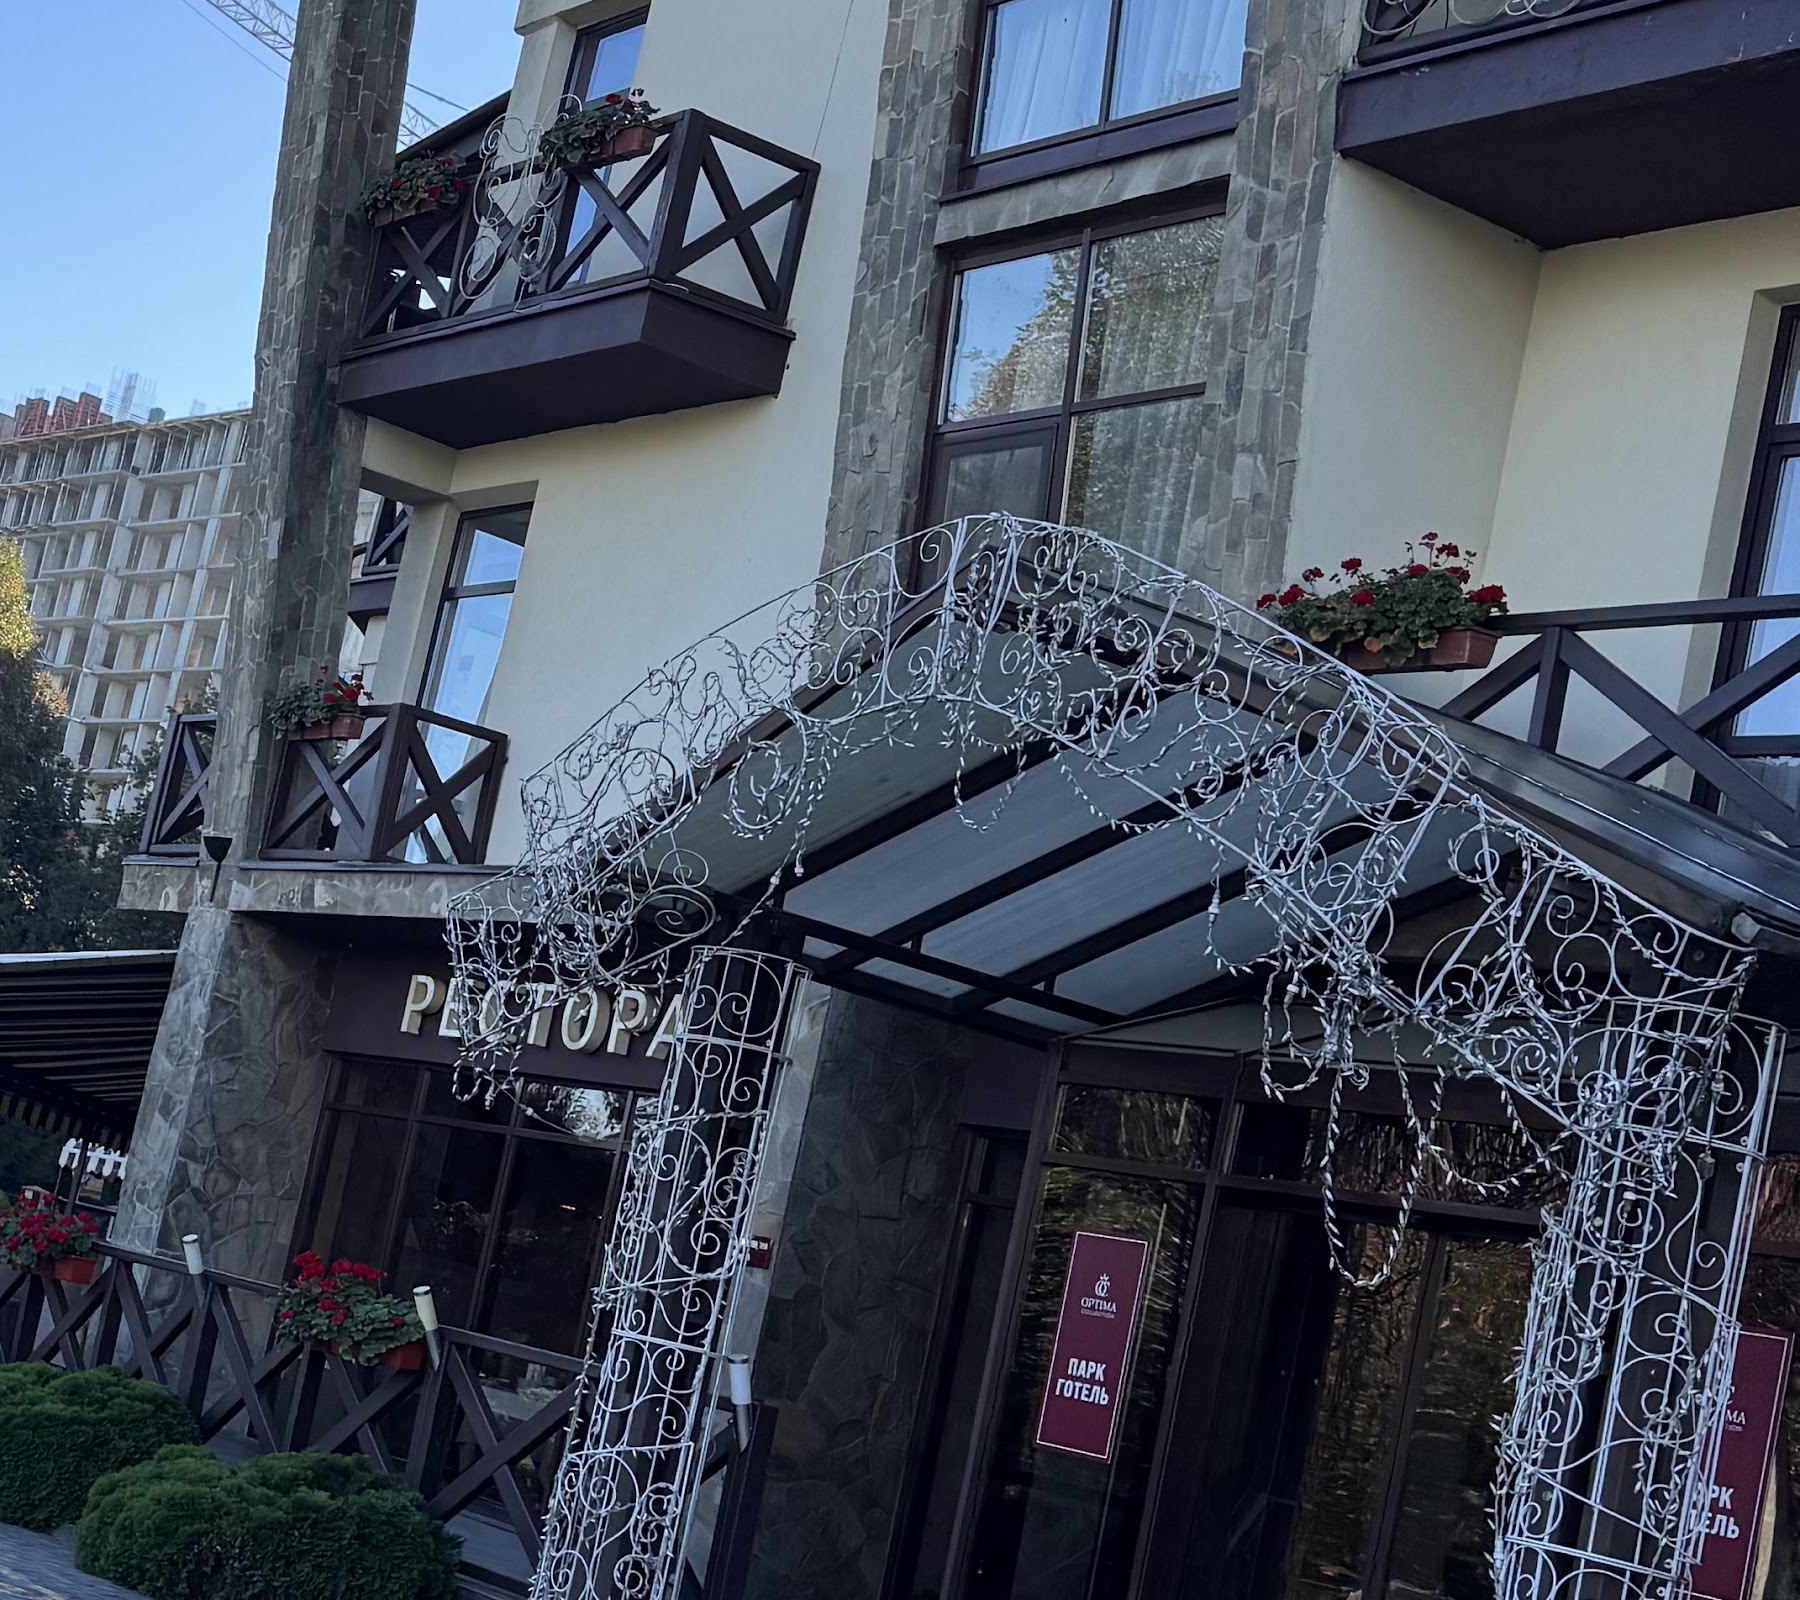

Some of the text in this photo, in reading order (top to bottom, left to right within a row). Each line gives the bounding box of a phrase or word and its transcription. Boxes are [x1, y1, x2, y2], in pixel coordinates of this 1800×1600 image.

[400, 974, 684, 1060] РЕСТОРА
[1080, 1296, 1117, 1313] OPTIMA
[1067, 1357, 1107, 1382] ПАРК
[1055, 1378, 1109, 1405] ГОТЕЛЬ
